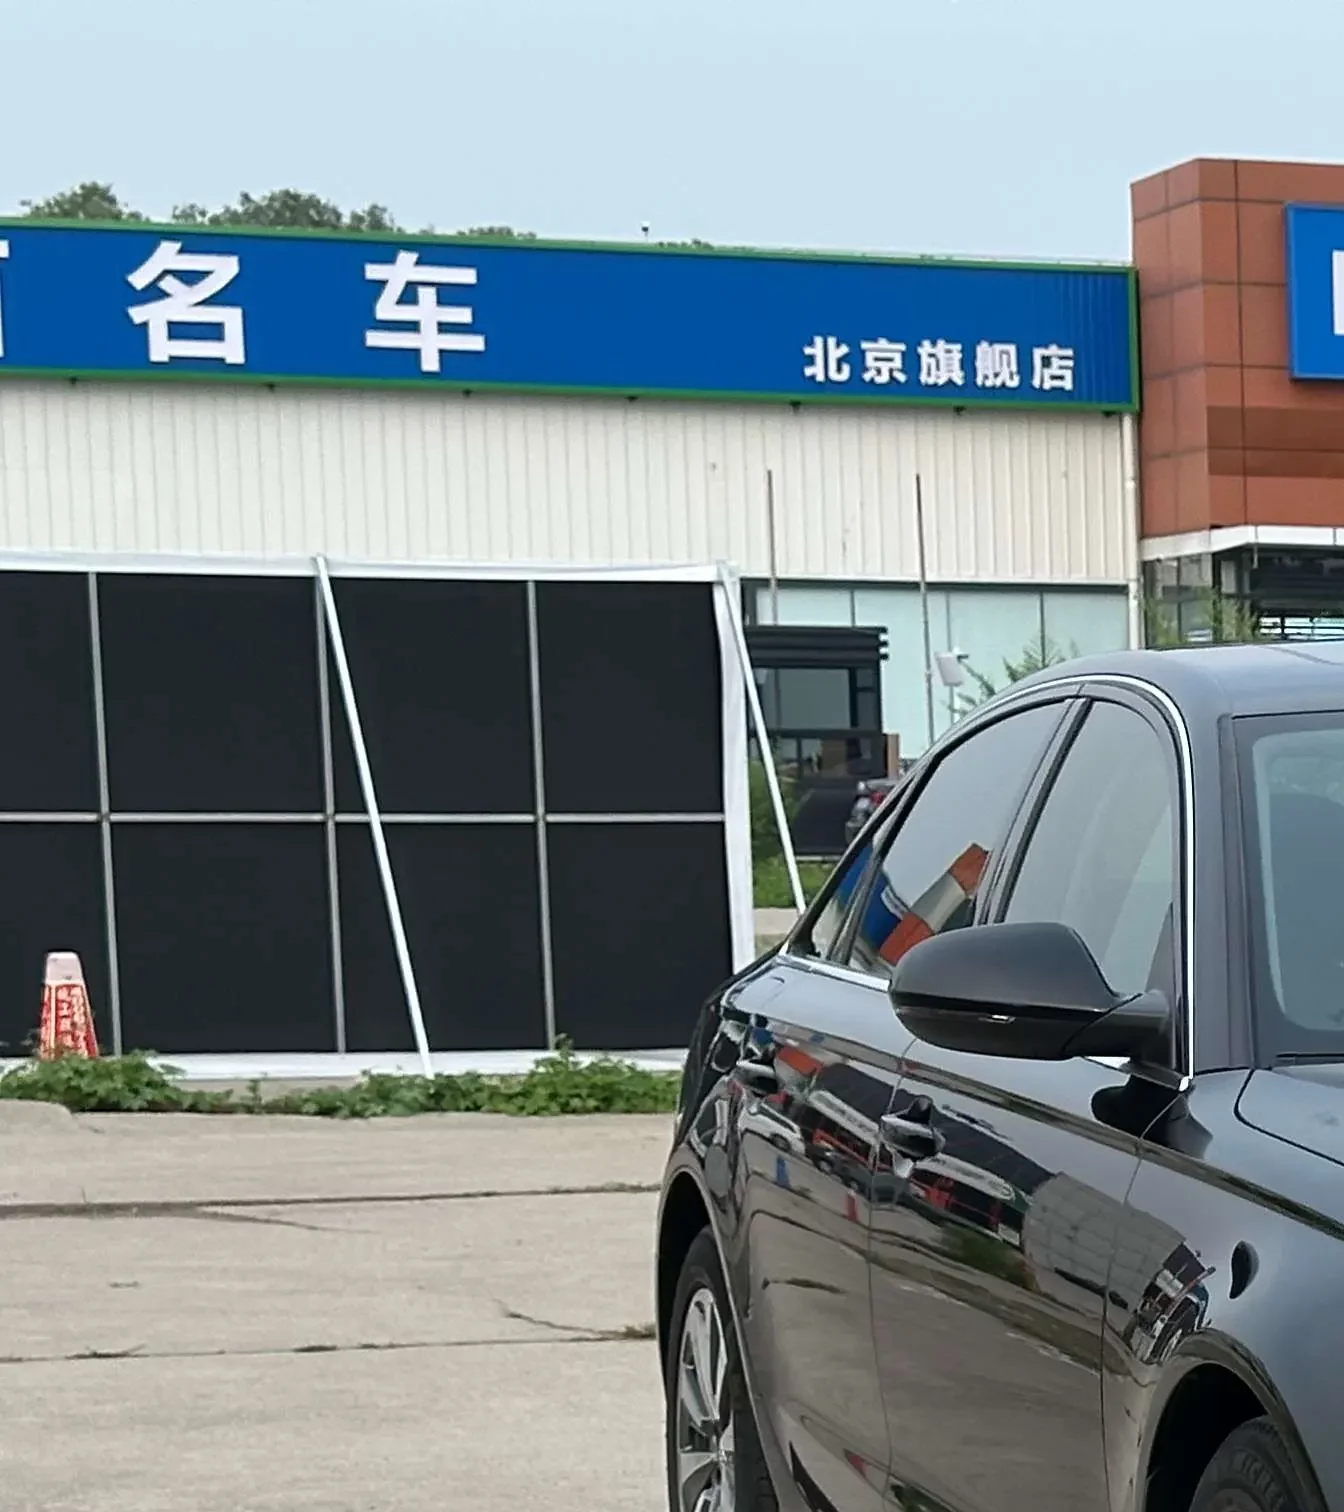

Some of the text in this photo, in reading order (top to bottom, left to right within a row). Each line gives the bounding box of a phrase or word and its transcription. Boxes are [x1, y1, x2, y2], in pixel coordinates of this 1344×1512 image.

[0, 238, 486, 373] 名车
[803, 335, 1076, 391] 北京旗舰店
